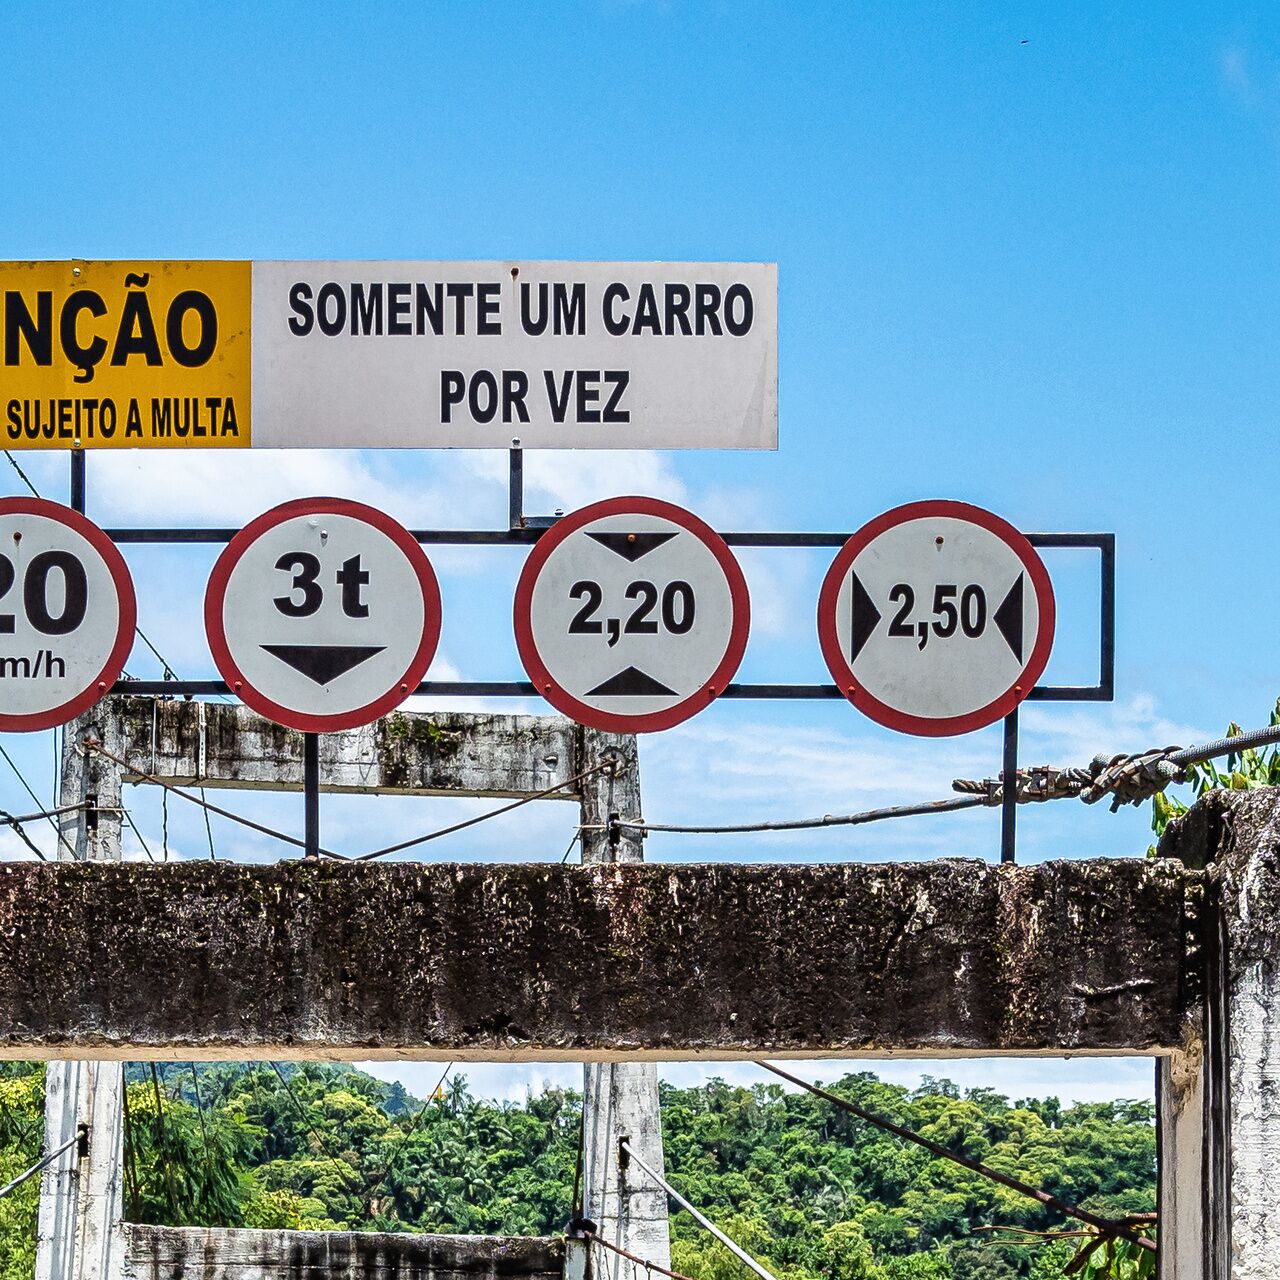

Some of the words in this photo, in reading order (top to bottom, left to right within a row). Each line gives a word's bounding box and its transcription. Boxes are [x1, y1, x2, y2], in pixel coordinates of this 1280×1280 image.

[288, 282, 502, 337] SOMENTE
[520, 283, 586, 336] UM
[602, 282, 754, 337] CARRO
[6, 397, 117, 440] SUJEITO
[124, 398, 144, 438] A
[151, 396, 239, 438] MULTA
[441, 369, 531, 424] POR
[543, 370, 630, 423] VEZ
[568, 580, 696, 648] 2,20
[887, 583, 987, 652] 2,50
